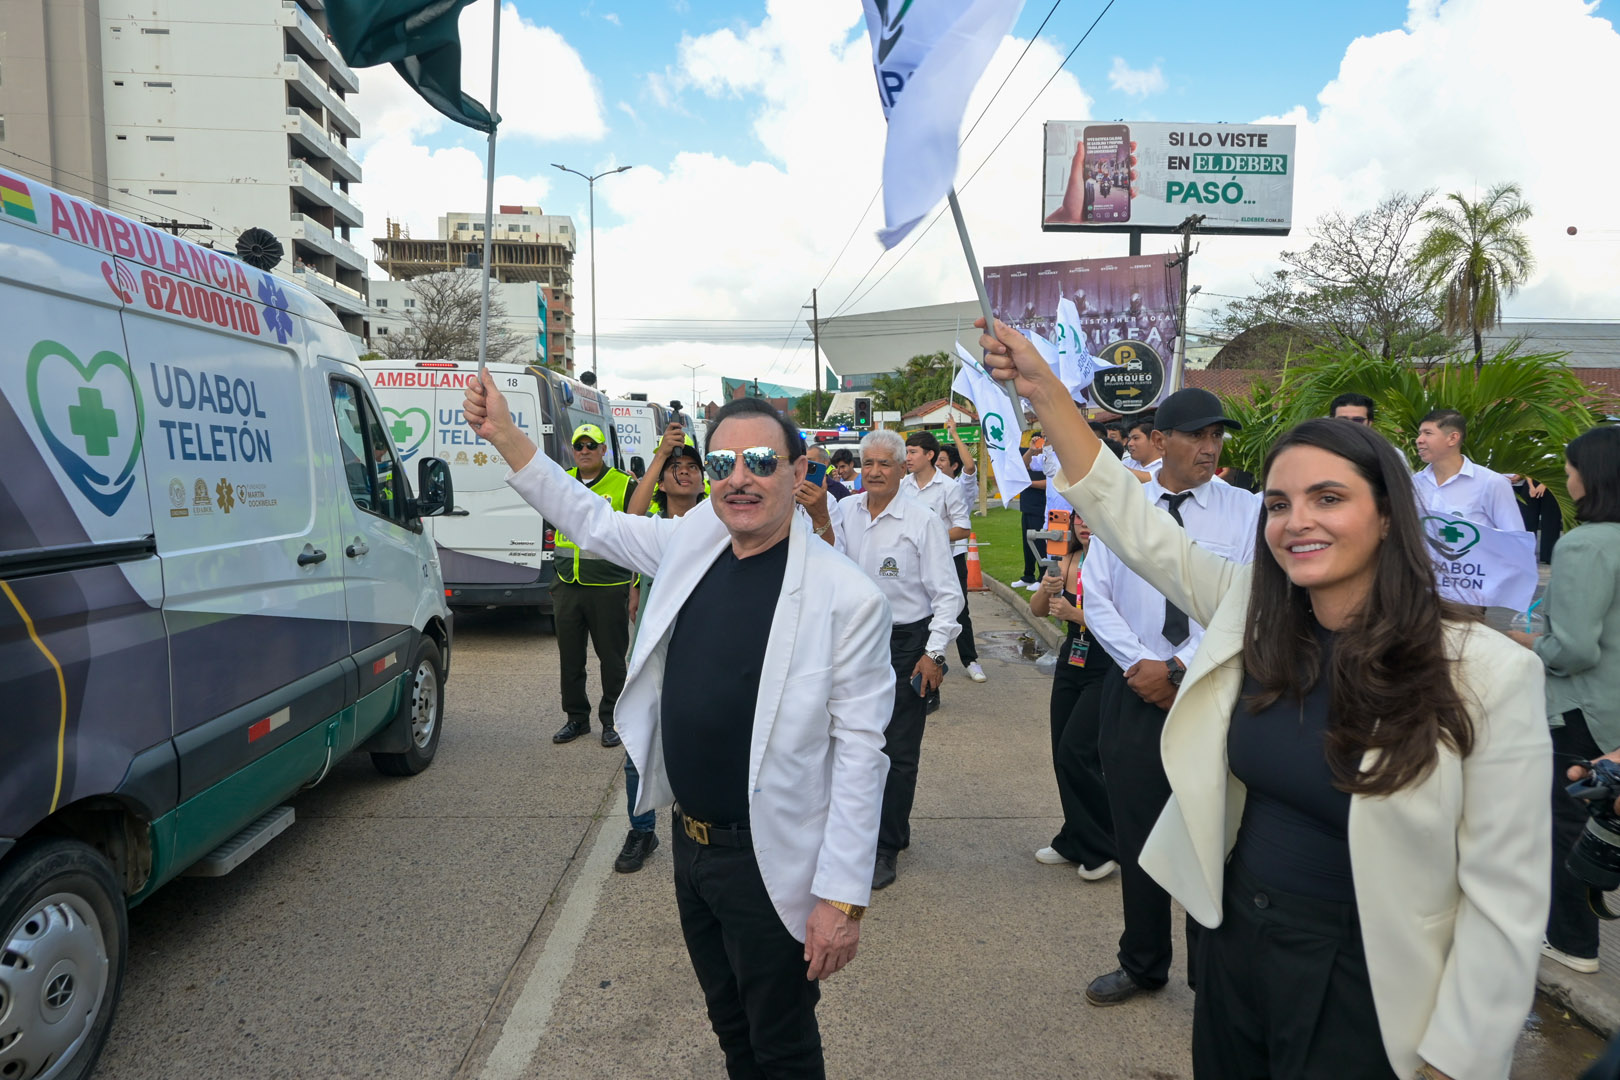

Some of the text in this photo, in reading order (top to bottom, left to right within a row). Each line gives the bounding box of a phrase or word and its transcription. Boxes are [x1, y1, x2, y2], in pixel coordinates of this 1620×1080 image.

[1169, 132, 1268, 147] SI LO VISTE
[1168, 155, 1285, 172] EN EL DEBER
[1165, 175, 1256, 204] PASÓ...
[49, 192, 253, 298] AMBULANCIA
[141, 269, 260, 336] 62000110
[1080, 316, 1137, 325] RISTOPHER
[374, 372, 477, 388] AMBULANC
[506, 378, 518, 387] 18
[1104, 374, 1152, 383] PARQUEO
[150, 362, 267, 419] UDABOL
[616, 424, 641, 434] BOL
[159, 420, 273, 463] TELETÓN
[618, 433, 641, 445] TÓN
[422, 563, 428, 578] 12
